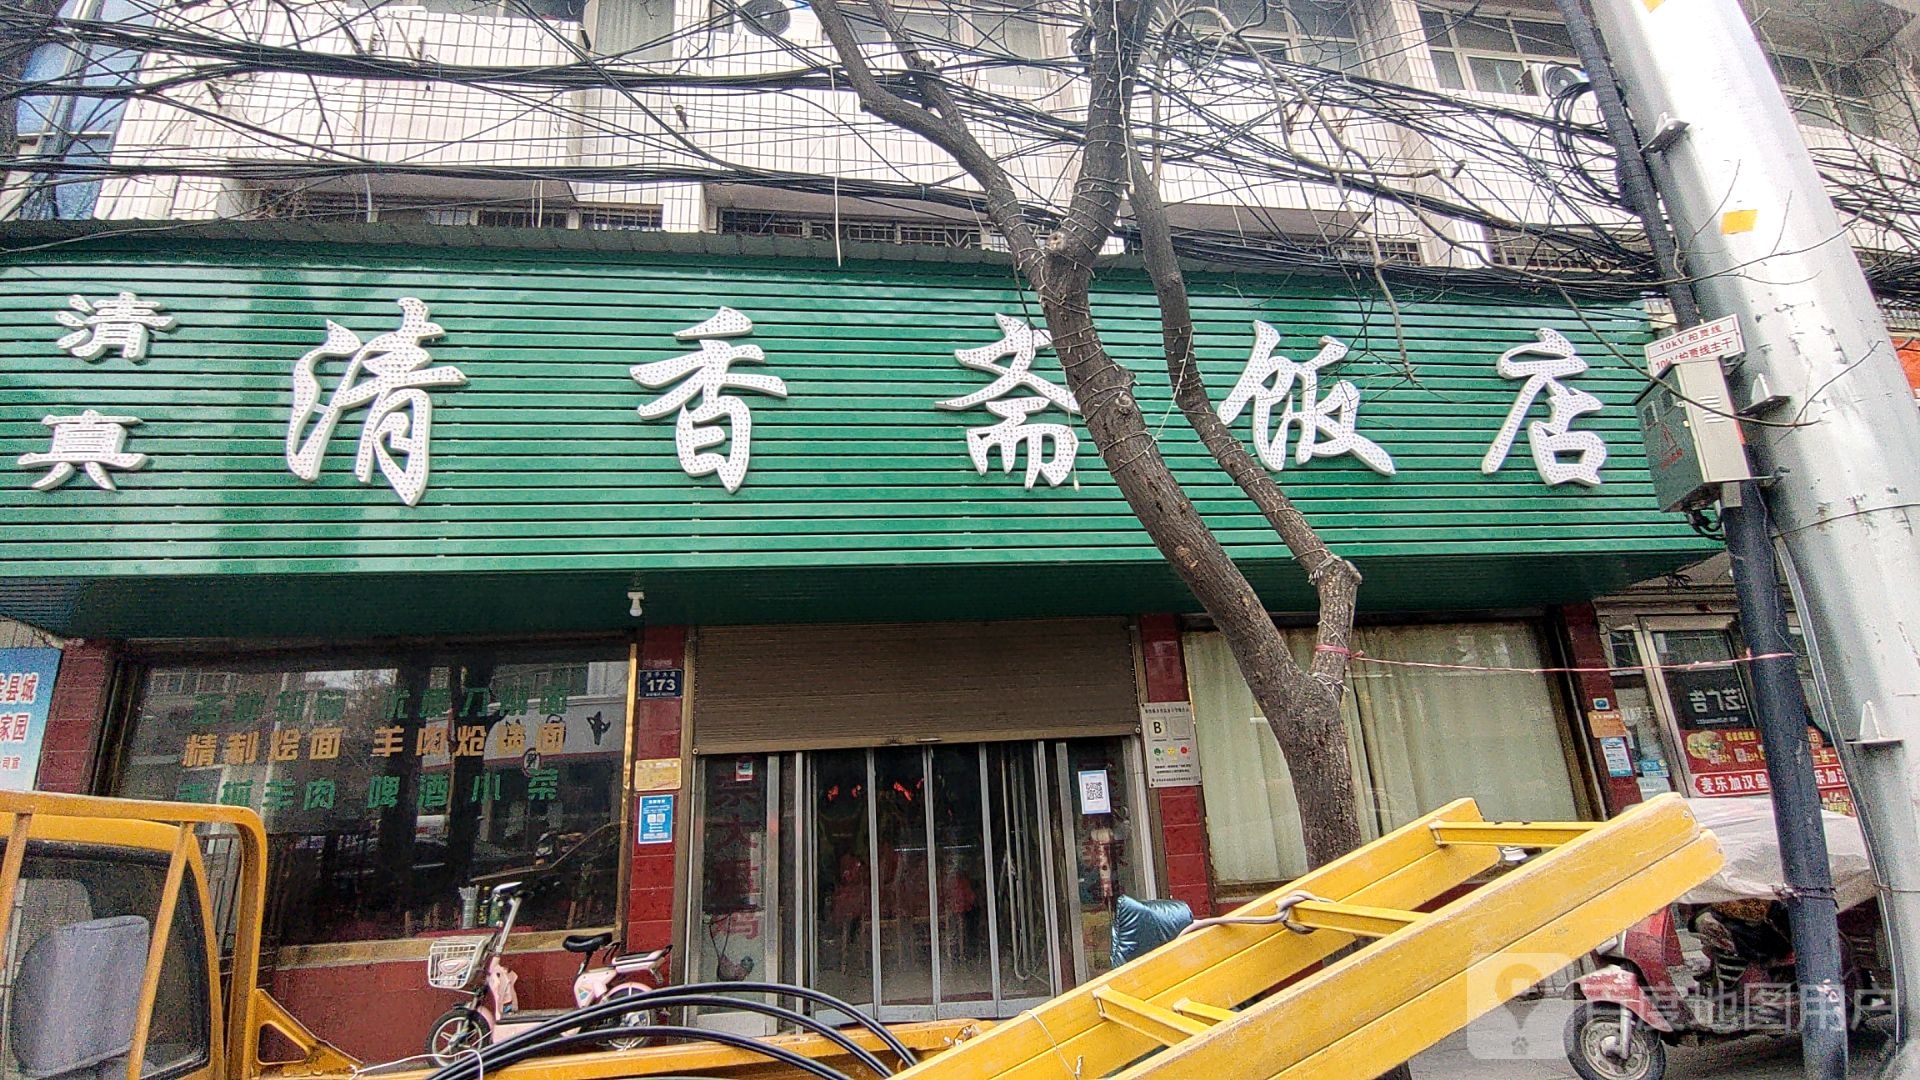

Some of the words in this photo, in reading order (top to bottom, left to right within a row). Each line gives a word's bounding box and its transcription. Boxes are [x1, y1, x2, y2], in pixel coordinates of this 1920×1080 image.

[1659, 336, 1686, 352] 10kV
[17, 291, 179, 492] 清真
[285, 296, 1610, 507] 清香斋饭店
[646, 678, 677, 692] 173
[1153, 721, 1163, 735] B
[182, 727, 344, 767] 精制烩面
